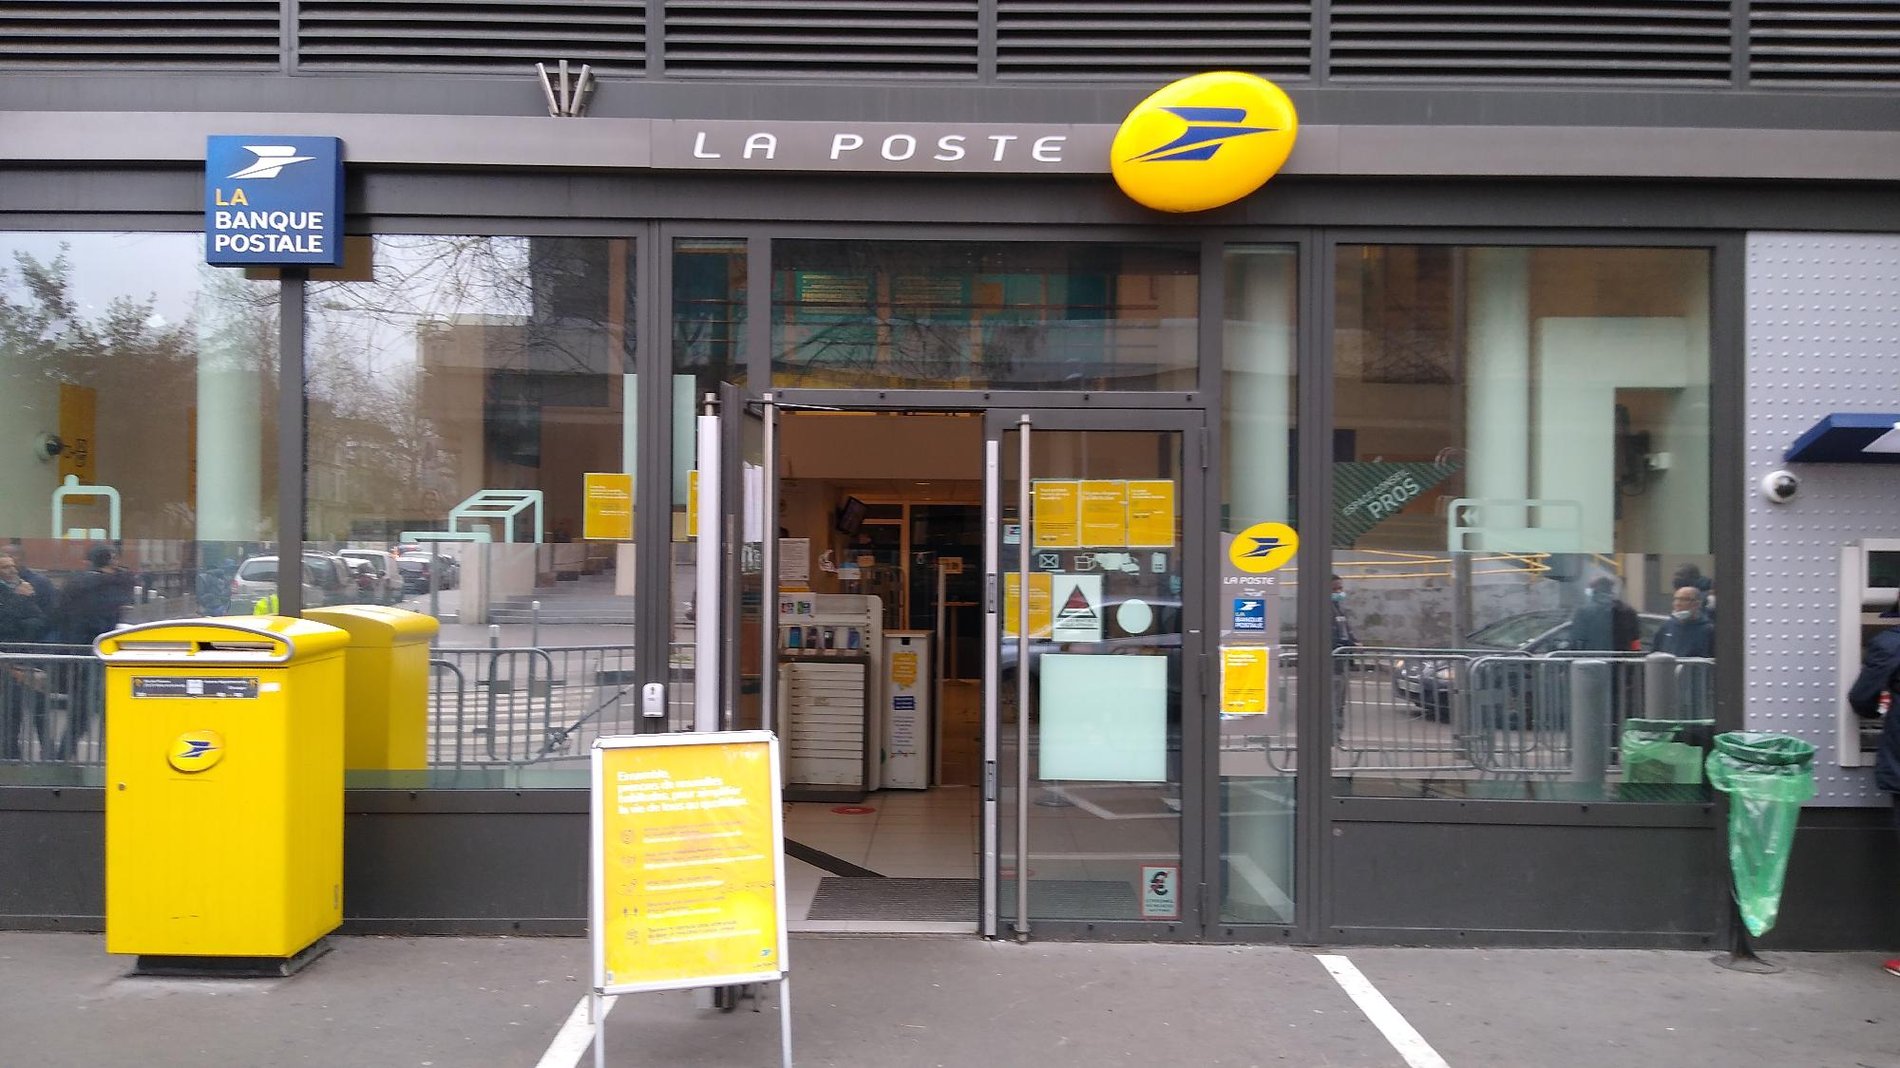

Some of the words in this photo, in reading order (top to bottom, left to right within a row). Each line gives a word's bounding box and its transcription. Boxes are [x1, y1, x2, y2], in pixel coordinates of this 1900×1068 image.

[693, 132, 777, 160] LA
[829, 133, 1067, 162] POSTE
[215, 188, 249, 206] LA
[215, 211, 324, 232] BANQUE
[215, 233, 324, 253] POSTALE
[1367, 477, 1420, 519] PROS
[1223, 576, 1238, 585] LA
[1239, 576, 1276, 585] POSTE
